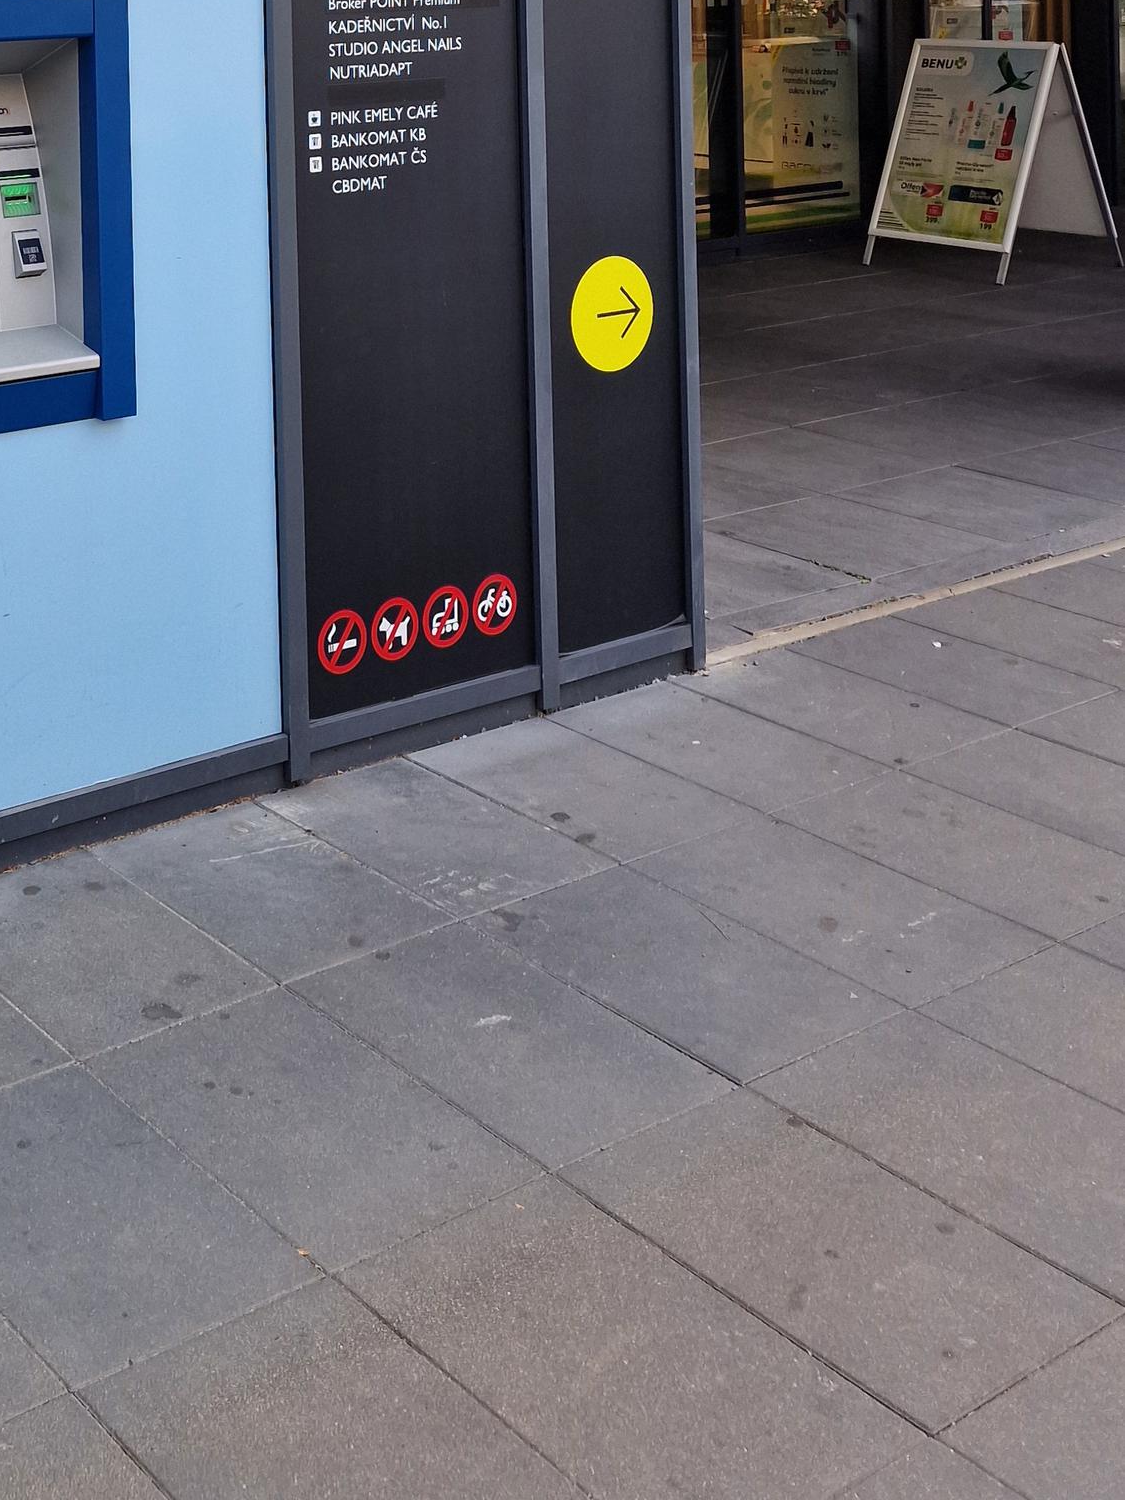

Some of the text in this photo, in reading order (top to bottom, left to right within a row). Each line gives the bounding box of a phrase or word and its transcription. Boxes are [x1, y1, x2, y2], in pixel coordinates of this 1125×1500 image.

[328, 14, 415, 34] KADEŘNICTVÍ
[328, 37, 462, 57] STUDIO ANGEL NAILS
[329, 62, 413, 80] NUTRIADAPT
[921, 58, 954, 69] BENU
[330, 101, 438, 126] PINK EMELY CAFÉ
[331, 128, 427, 148] BANKOMAT KB
[331, 146, 427, 171] BANKOMAT ČS
[332, 176, 387, 194] CBDMAT
